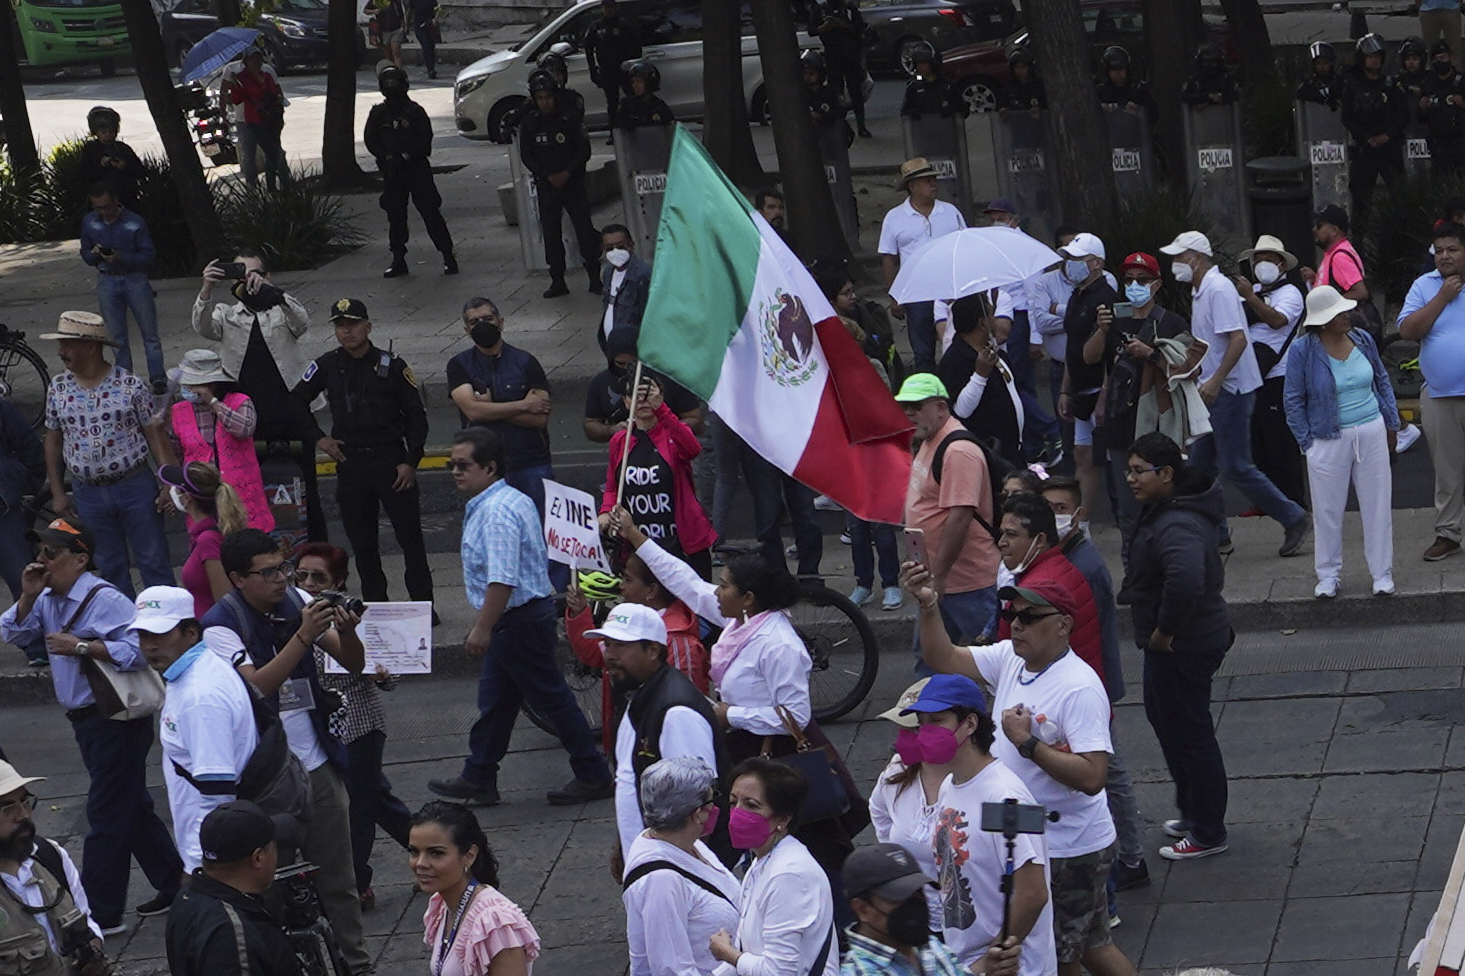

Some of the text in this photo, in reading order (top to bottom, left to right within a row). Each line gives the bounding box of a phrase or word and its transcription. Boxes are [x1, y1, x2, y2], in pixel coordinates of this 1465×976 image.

[1312, 147, 1343, 162] POLICIA
[1409, 141, 1432, 156] POLIC
[1113, 154, 1140, 169] OLICIA
[1200, 152, 1231, 166] POLICIA
[625, 465, 660, 486] RIDE
[626, 493, 671, 515] YOUR
[550, 497, 594, 531] EL INE
[637, 523, 678, 540] ORLD
[548, 527, 604, 568] NO SE TOCA!
